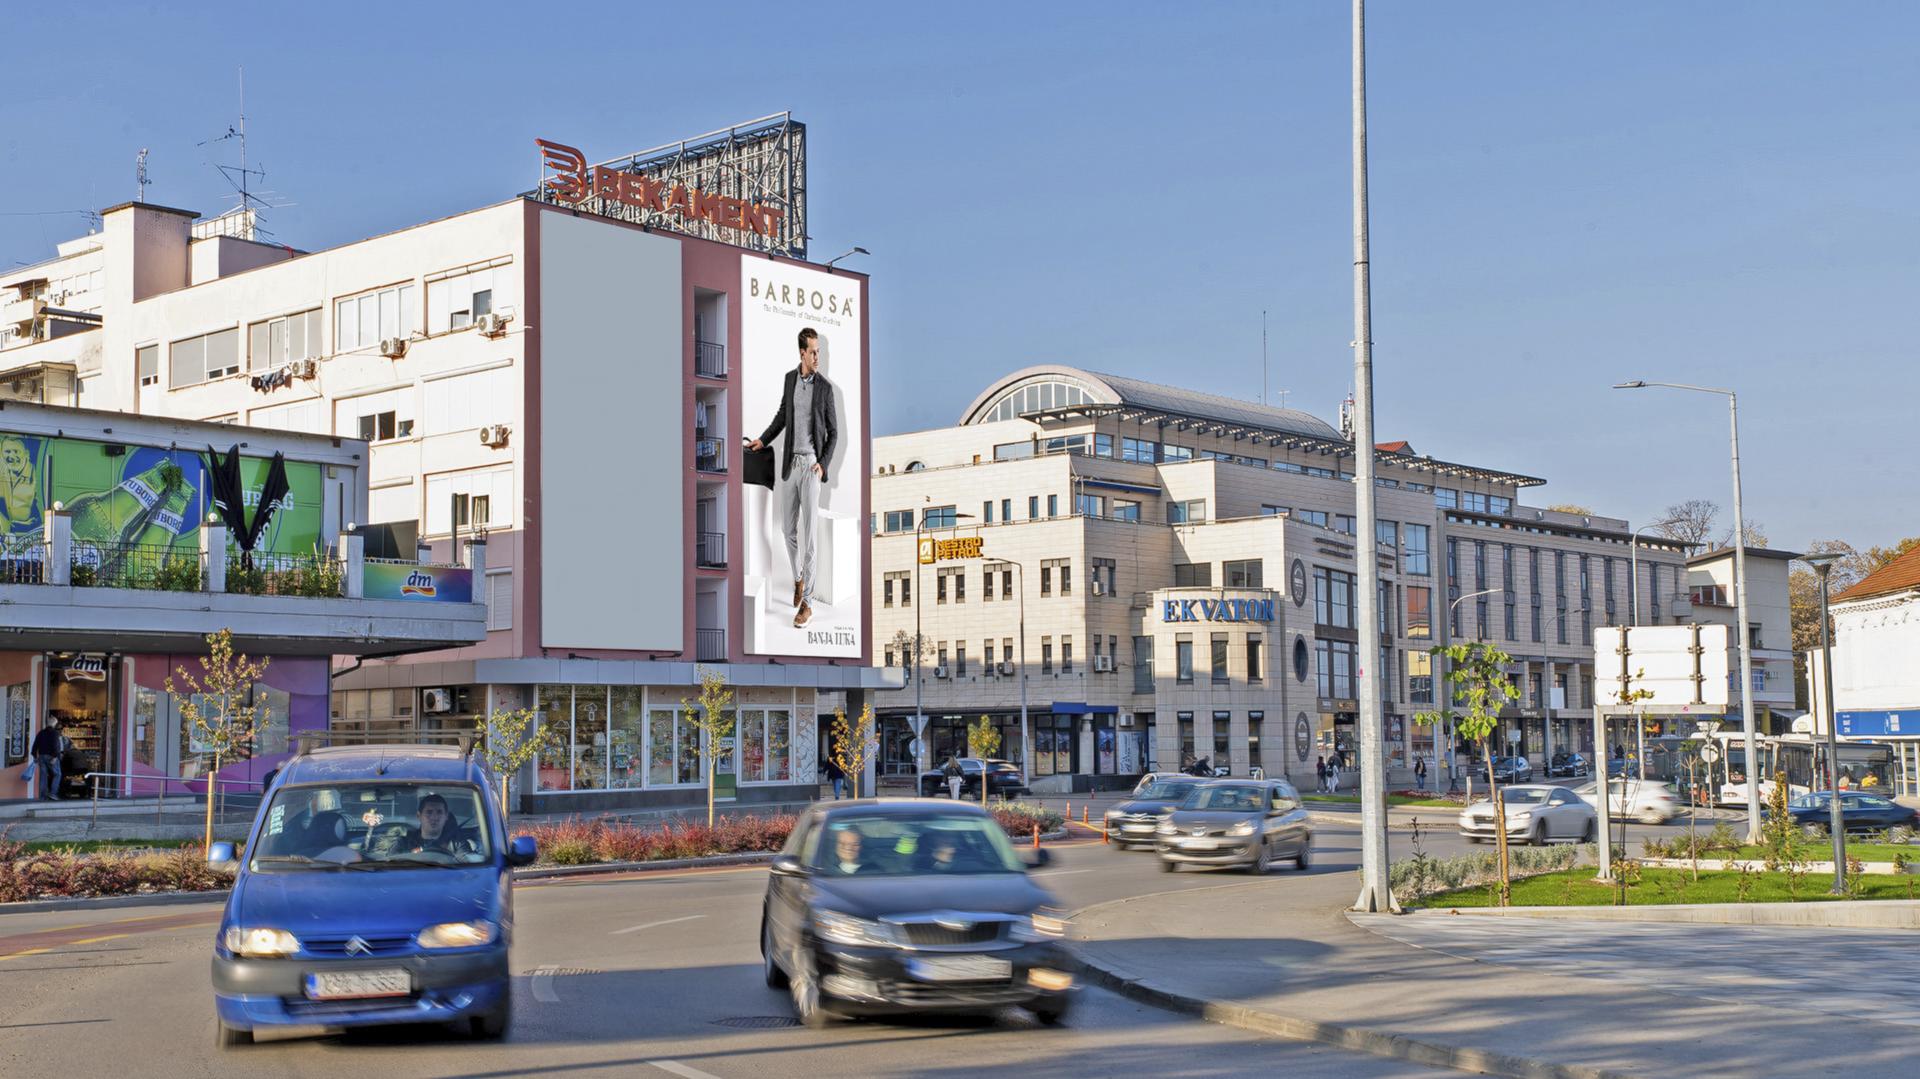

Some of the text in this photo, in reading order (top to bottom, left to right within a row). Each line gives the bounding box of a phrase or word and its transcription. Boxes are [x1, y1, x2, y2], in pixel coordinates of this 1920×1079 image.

[593, 165, 784, 238] BEKAMENT
[751, 277, 853, 317] BARBOSA
[936, 537, 983, 550] NESTRO
[936, 547, 983, 560] PETROL
[408, 570, 432, 587] dm
[1162, 599, 1275, 623] EKVATOR
[73, 654, 101, 671] dm
